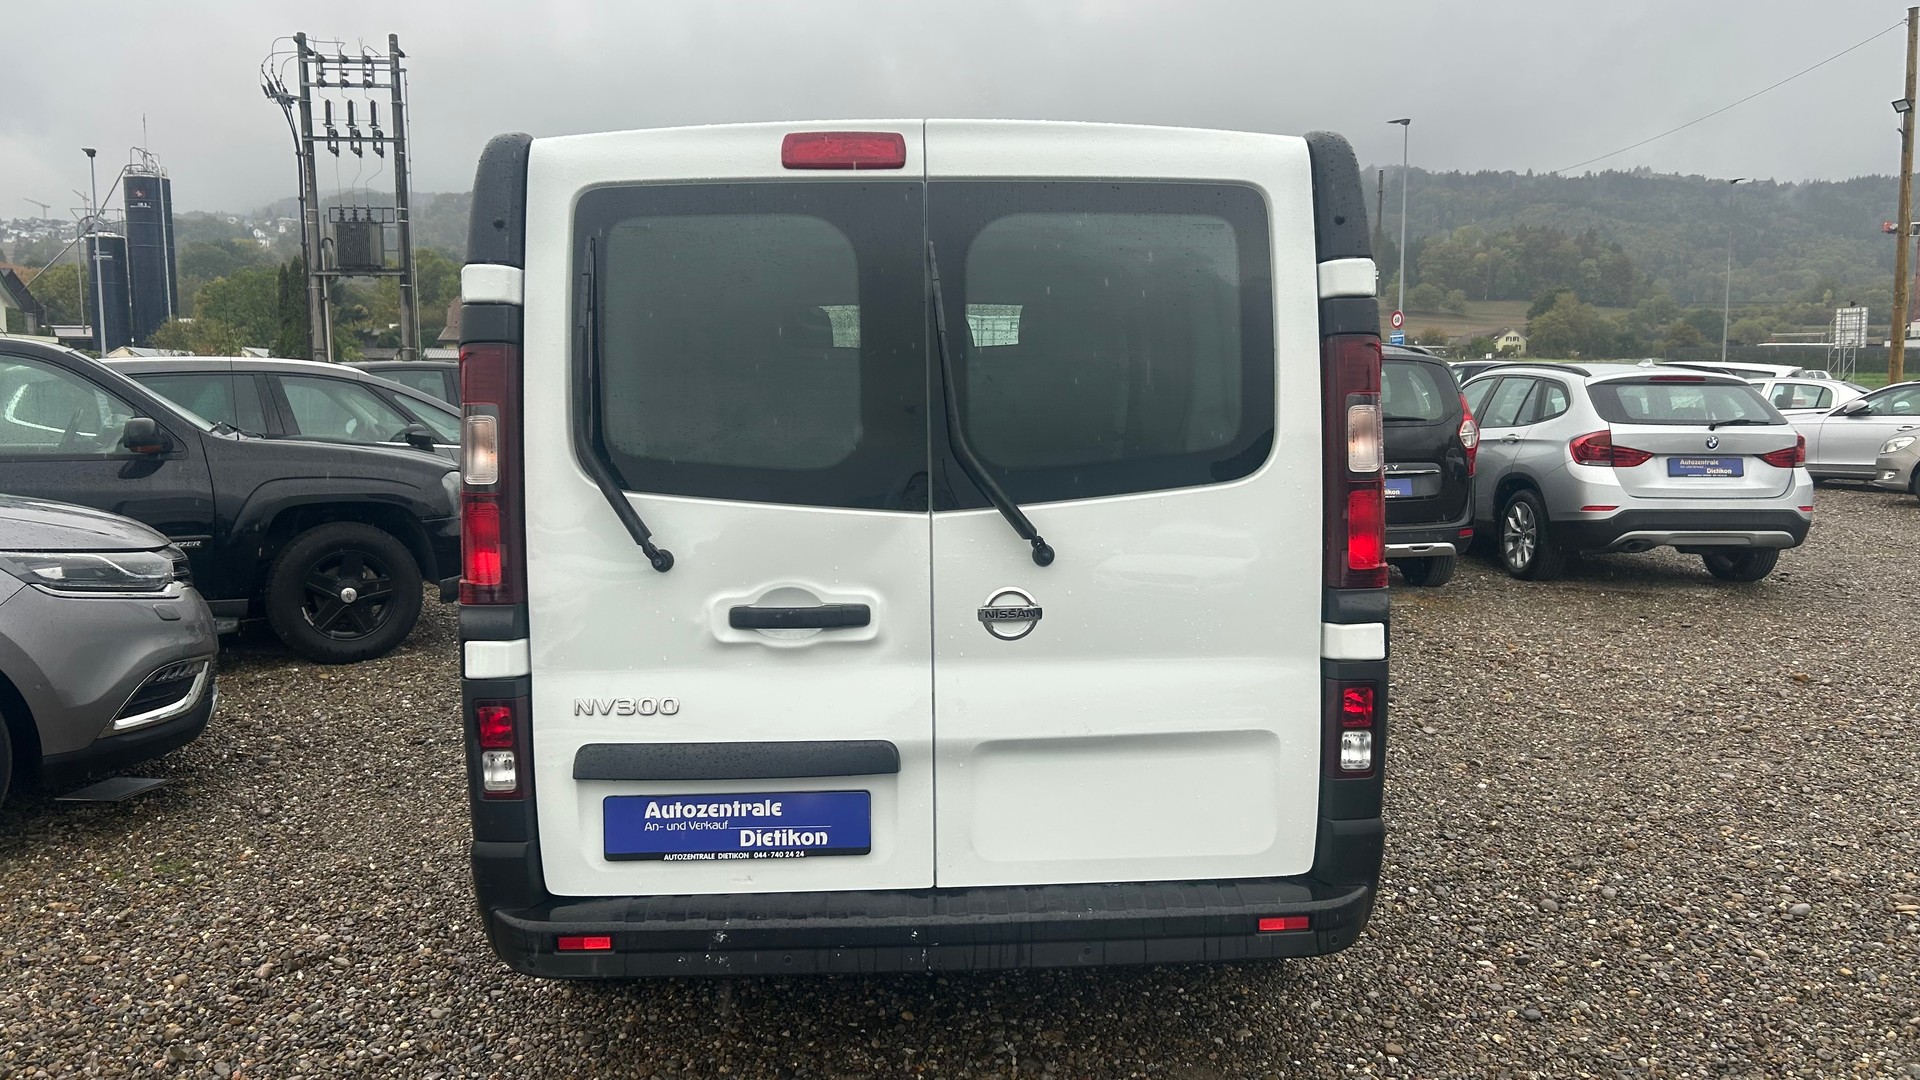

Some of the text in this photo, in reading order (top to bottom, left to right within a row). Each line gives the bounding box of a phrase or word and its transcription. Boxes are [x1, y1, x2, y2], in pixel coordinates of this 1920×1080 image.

[984, 610, 1036, 619] NISSAN
[574, 697, 680, 716] NV300
[644, 799, 782, 819] Autozentrale
[644, 820, 729, 831] An- und Verkauf
[739, 828, 829, 847] Dietikon
[663, 852, 715, 861] AUTOZENTRALE
[717, 852, 749, 861] DIETIKON
[785, 850, 794, 858] 24
[795, 850, 805, 858] 24
